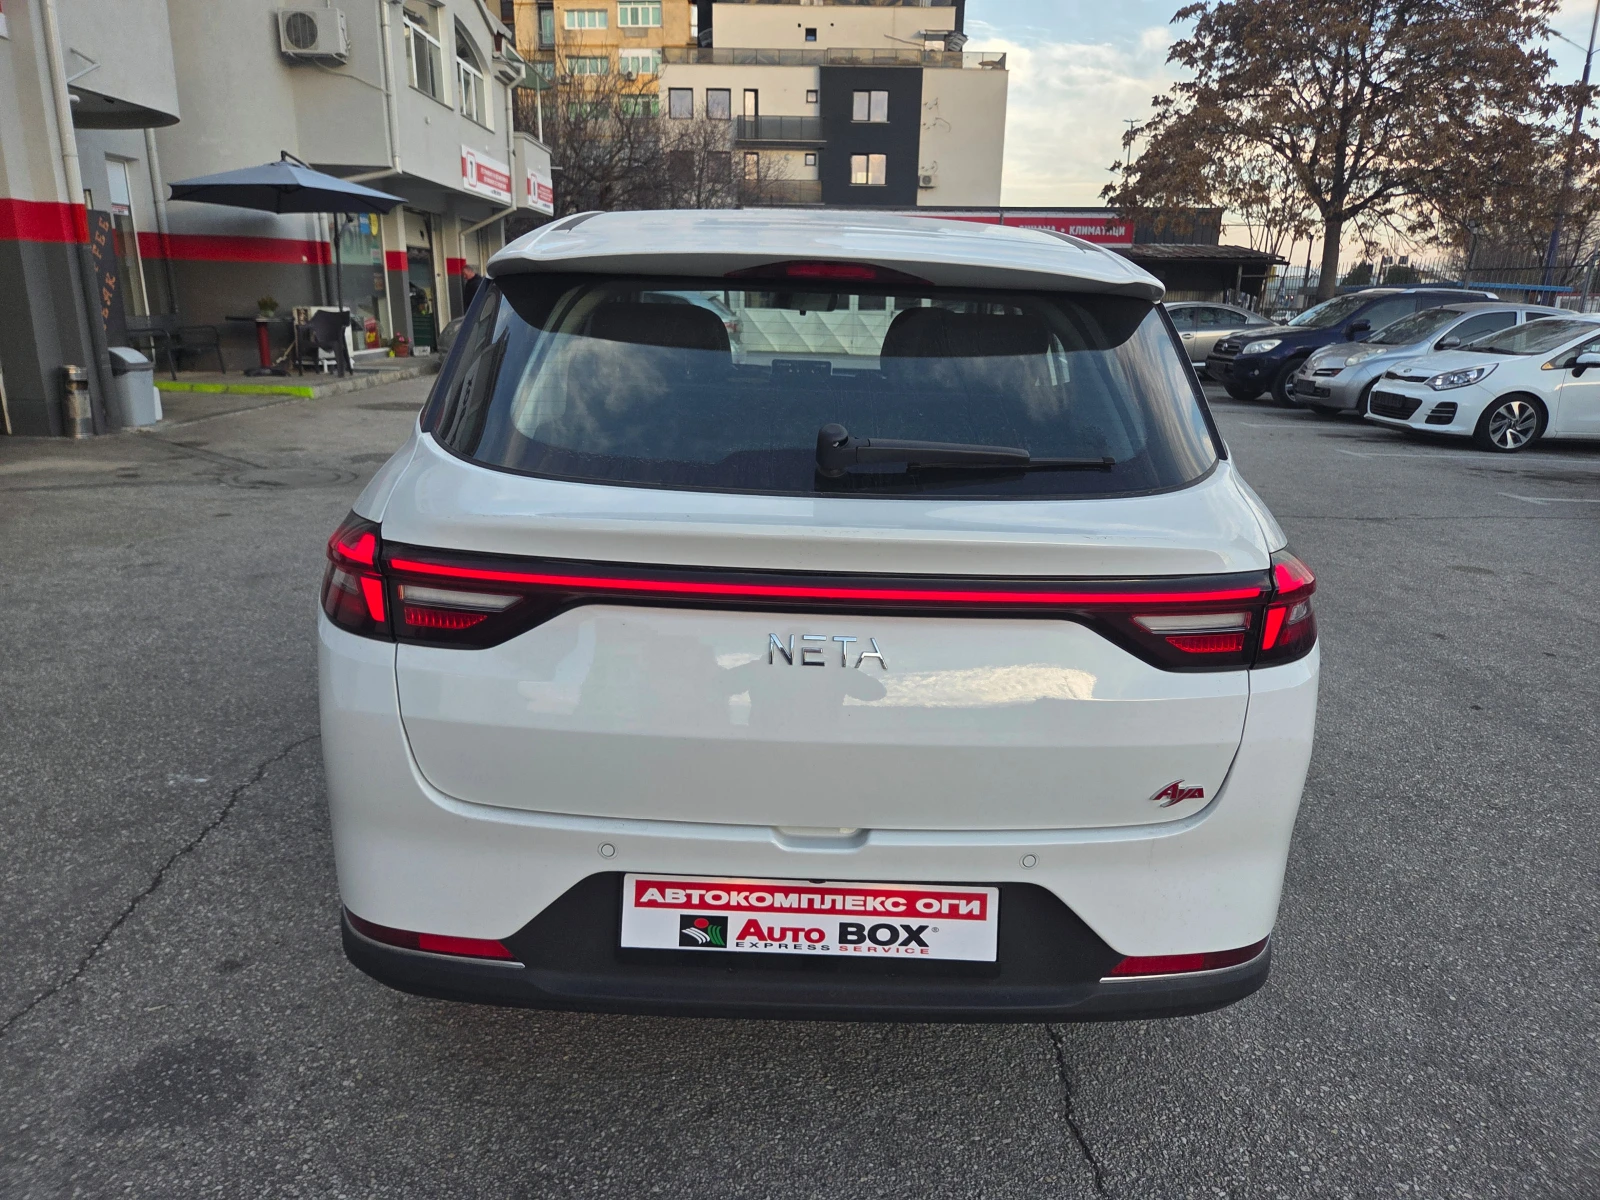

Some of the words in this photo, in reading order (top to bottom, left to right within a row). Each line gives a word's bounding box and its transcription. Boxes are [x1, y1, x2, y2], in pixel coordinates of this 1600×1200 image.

[769, 633, 888, 670] NETA
[639, 887, 907, 913] АВТОКОМПЛЕКС
[915, 898, 980, 915] ОГИ
[736, 941, 830, 951] EXPRESS
[839, 945, 930, 955] SERVICE
